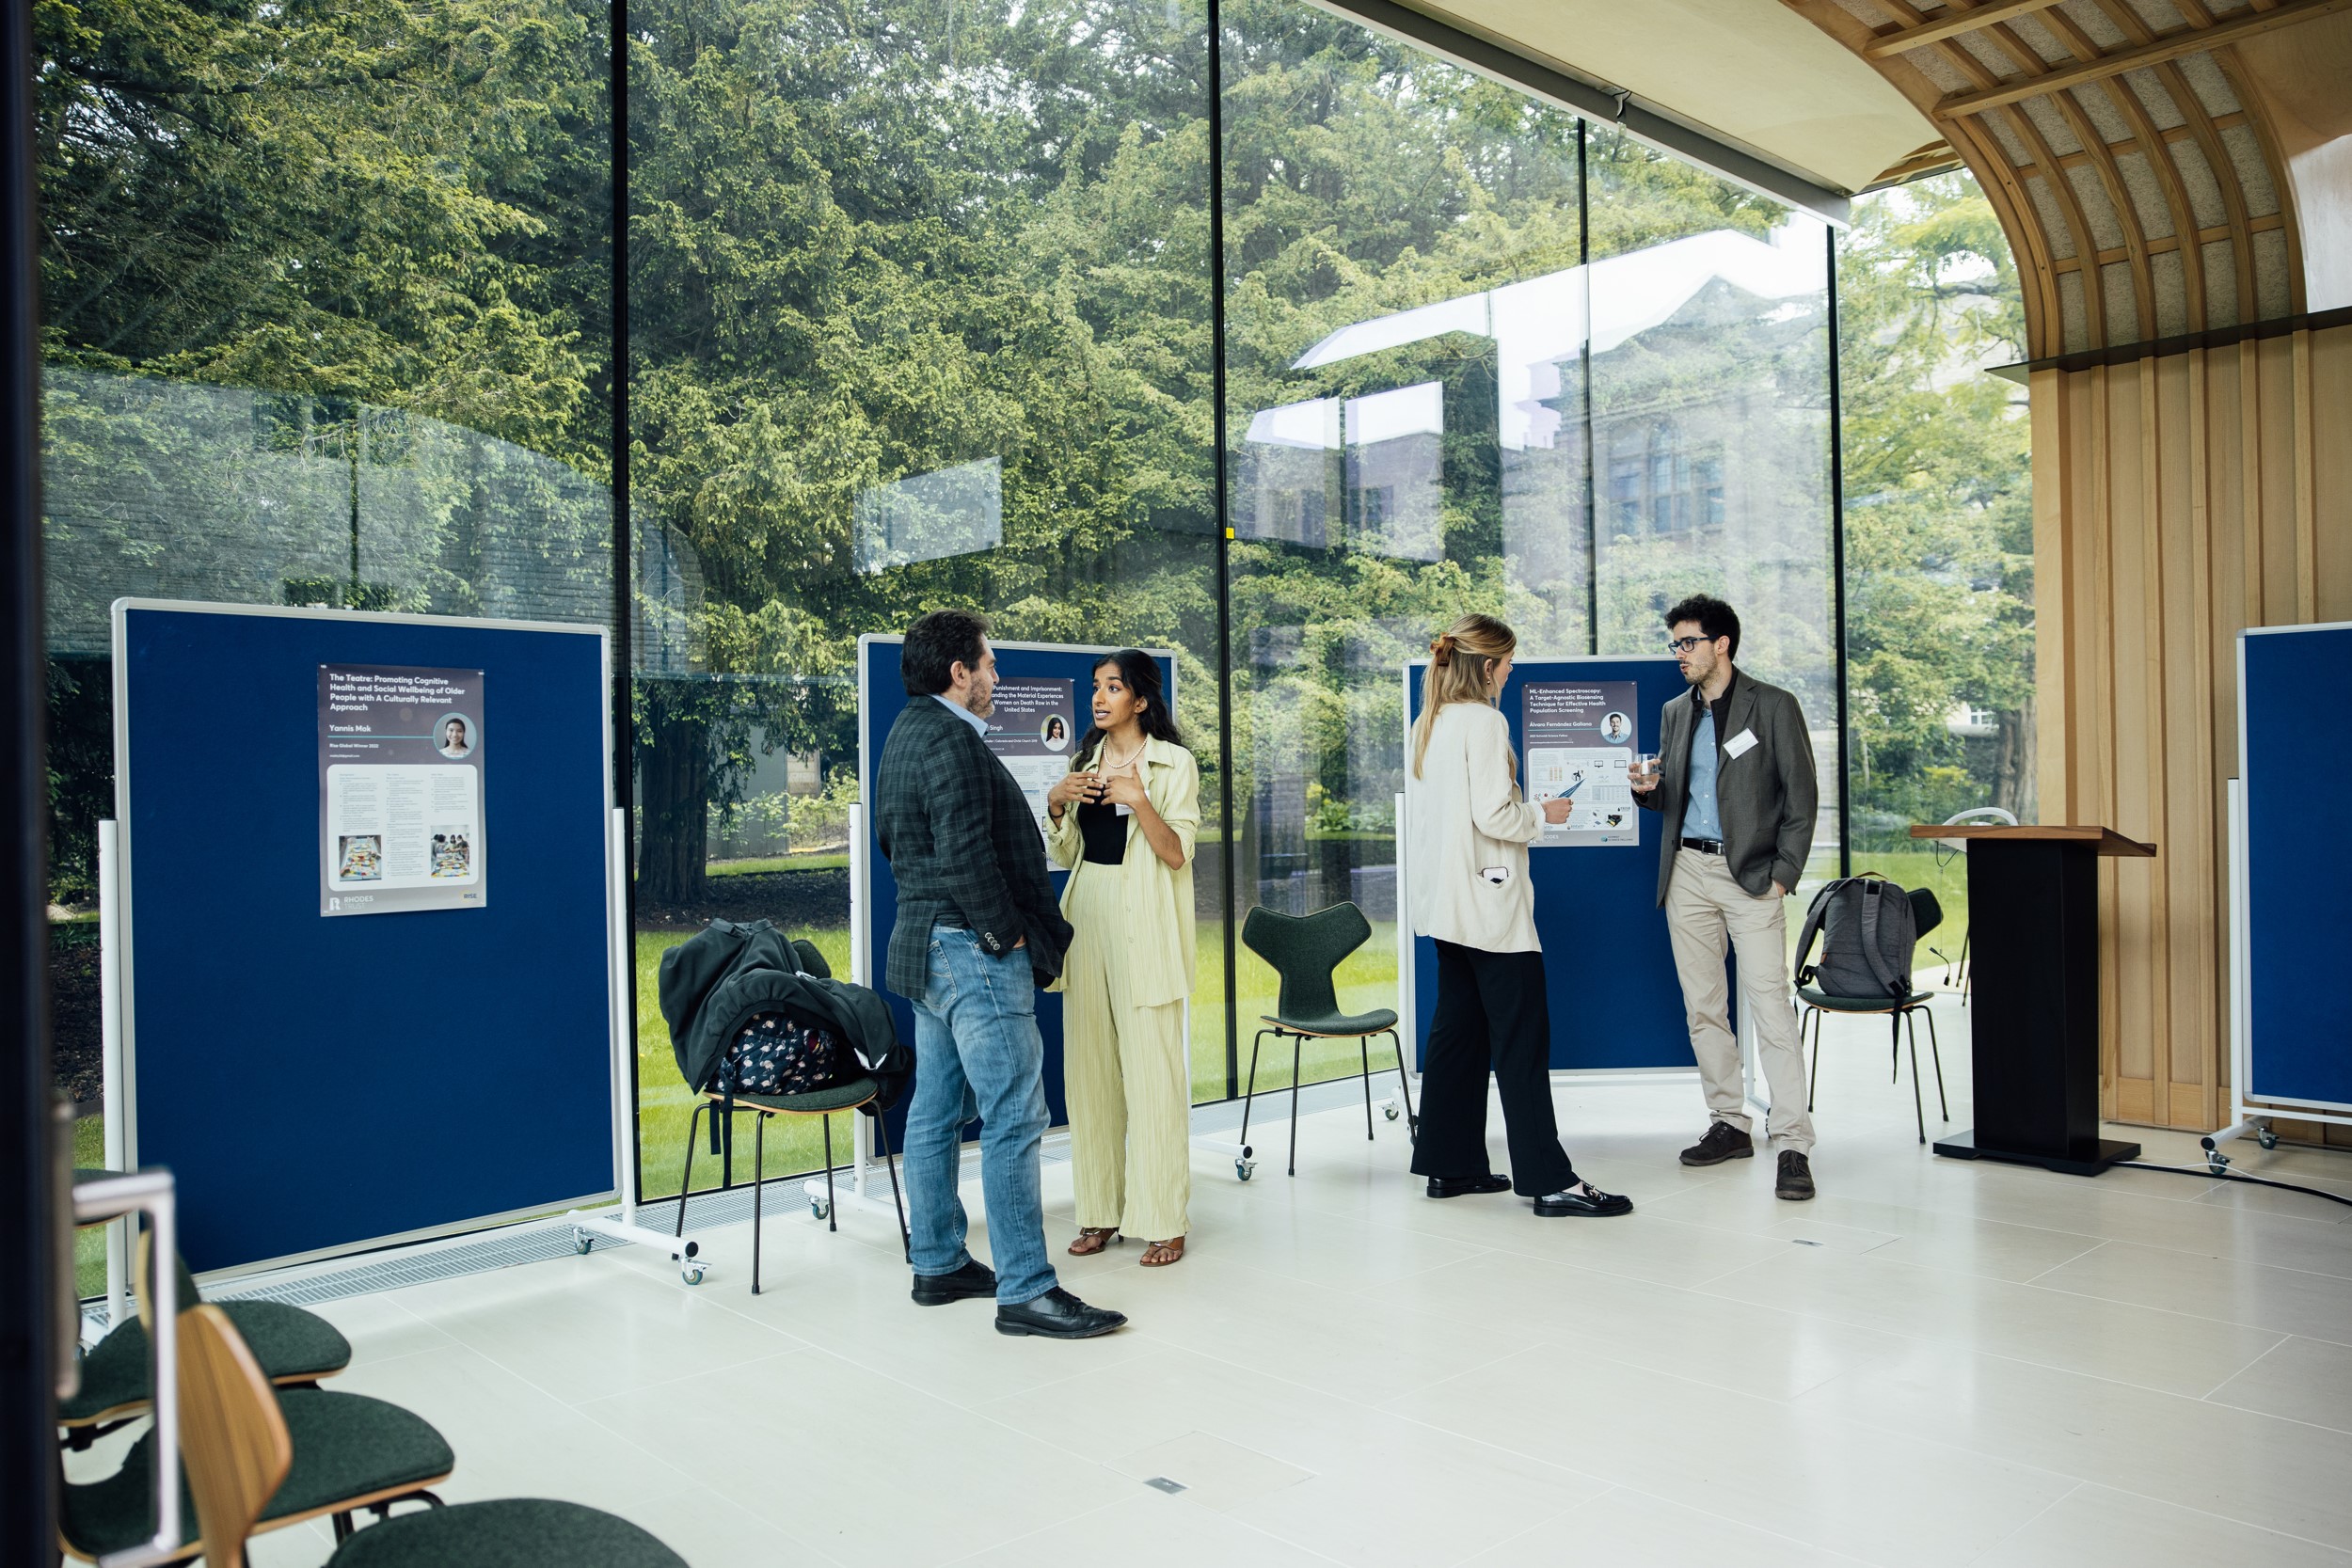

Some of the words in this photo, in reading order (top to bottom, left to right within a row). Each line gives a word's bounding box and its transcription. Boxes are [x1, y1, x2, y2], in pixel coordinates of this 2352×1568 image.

[374, 675, 413, 685] Promoting
[414, 677, 448, 685] Cognitive
[398, 686, 435, 695] Wellbeing
[330, 693, 356, 702] People
[384, 695, 419, 704] Culturally
[330, 703, 368, 712] Approach
